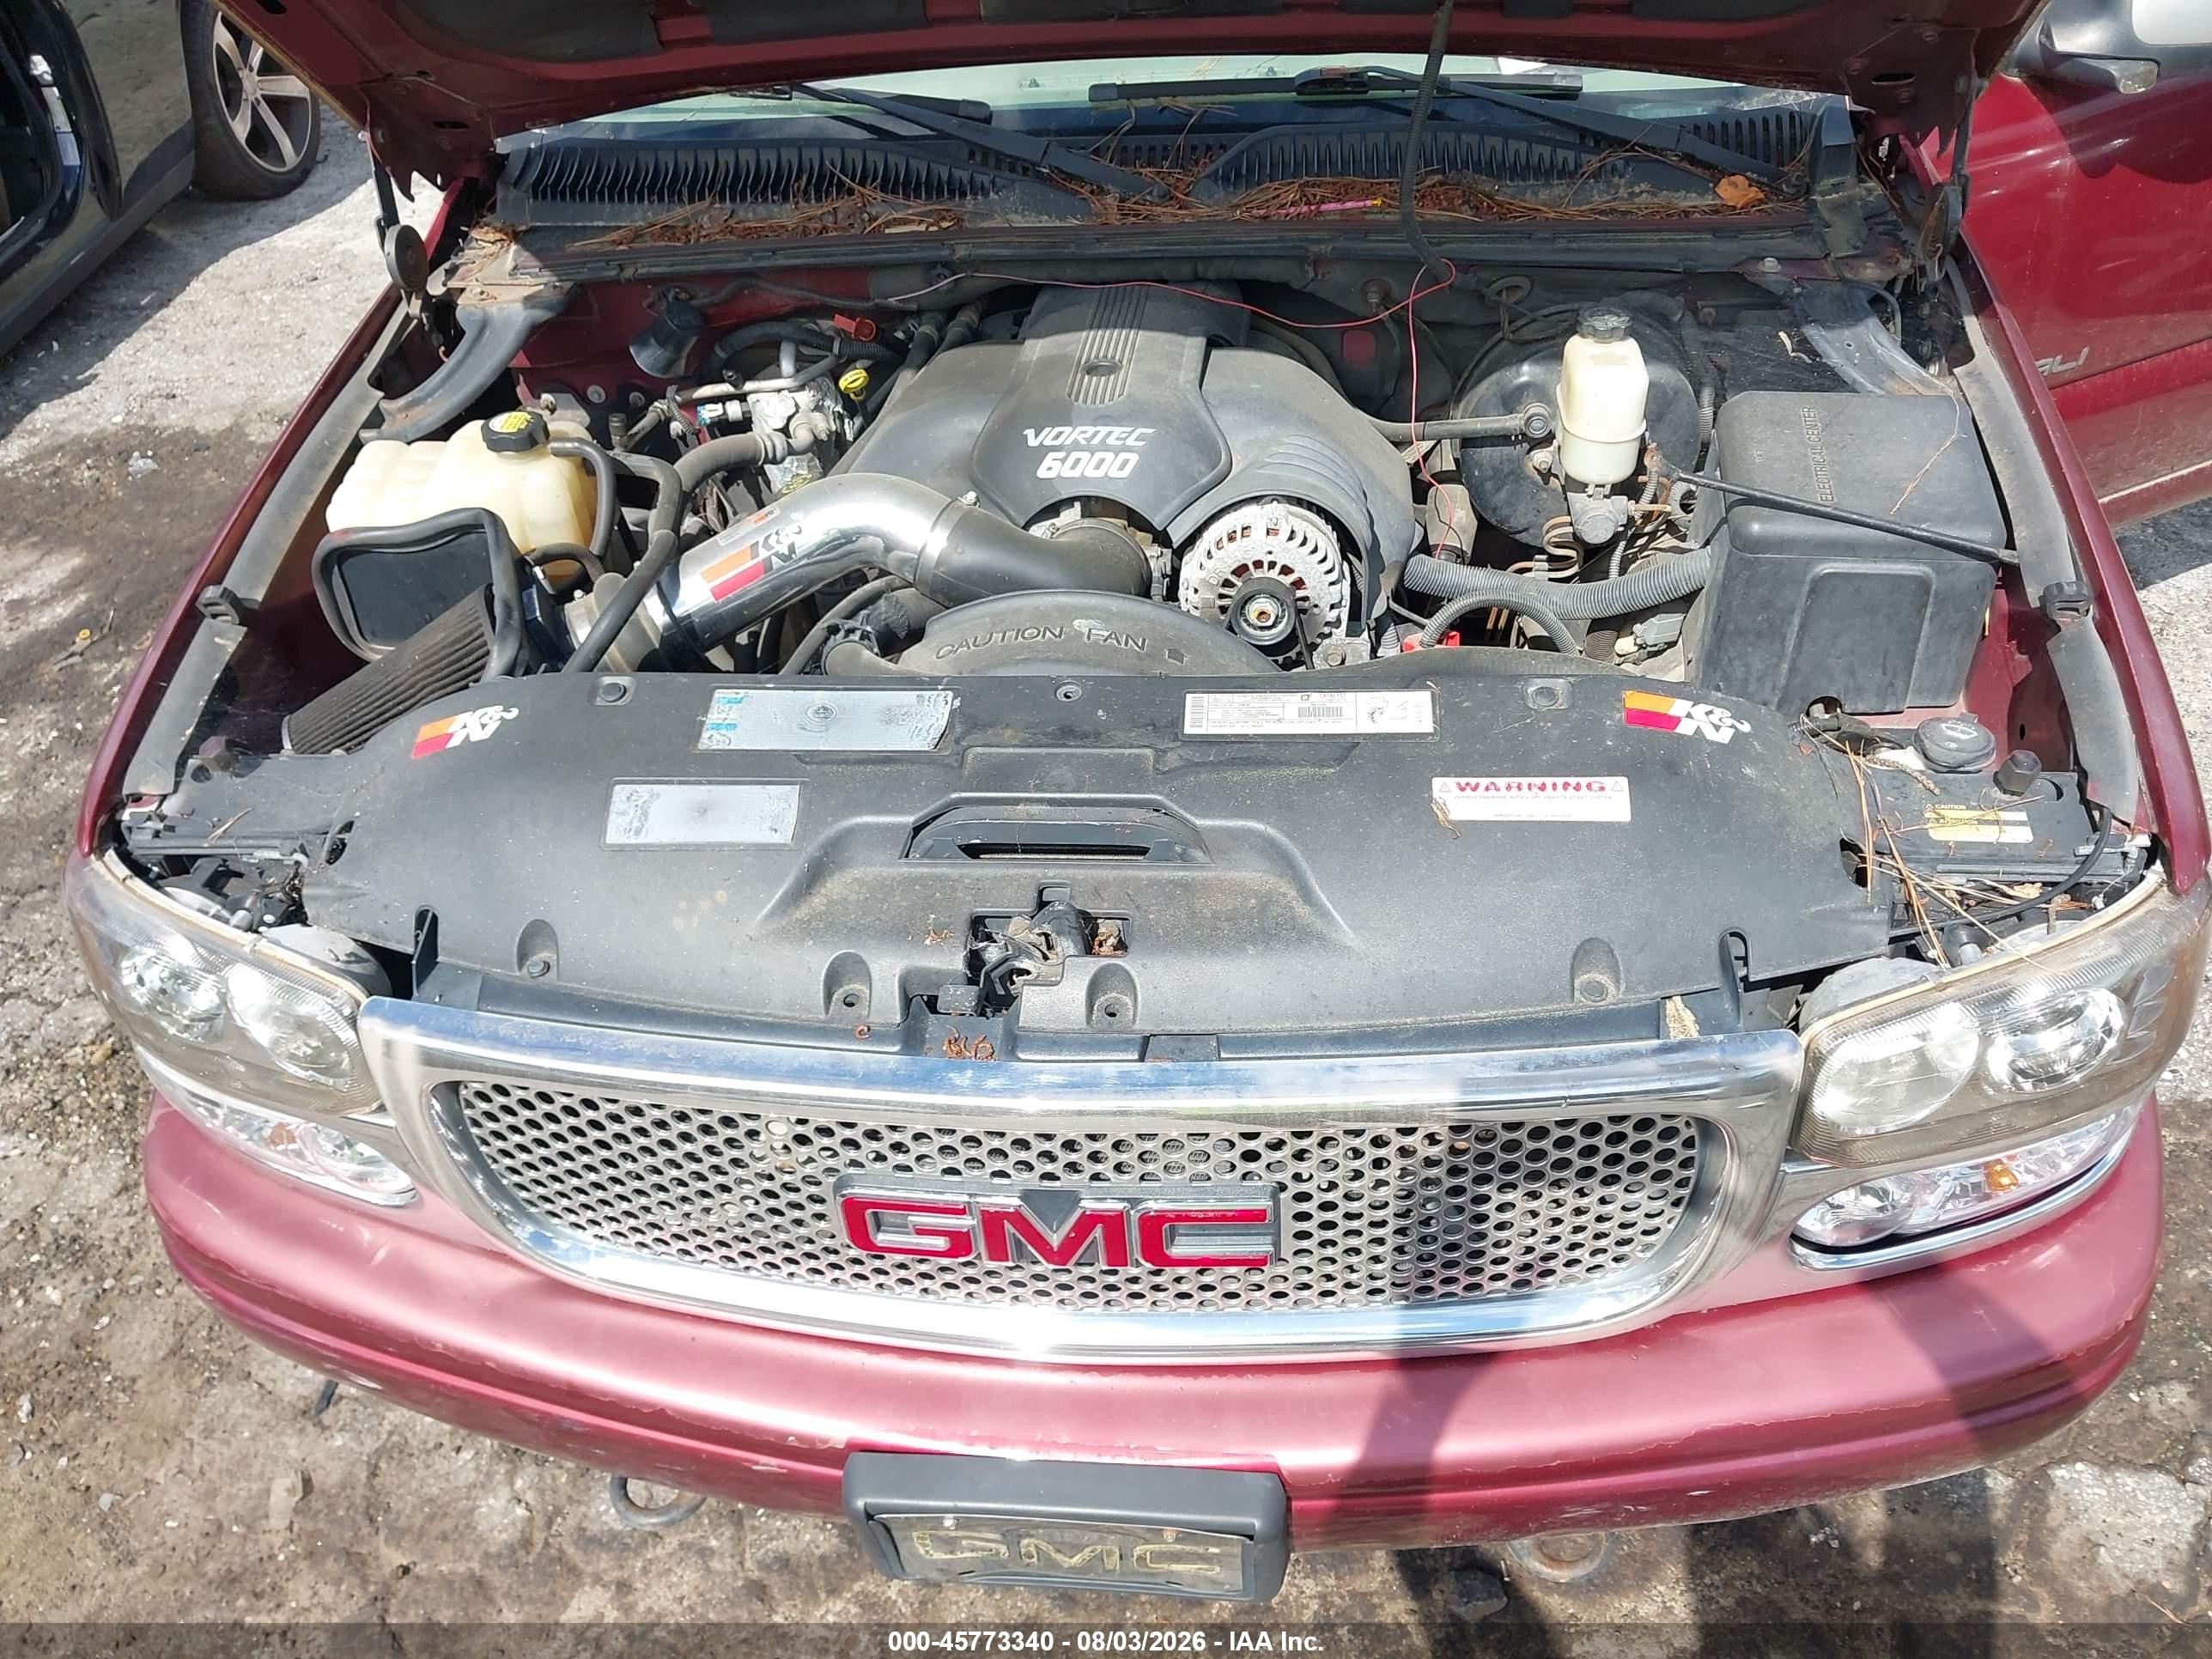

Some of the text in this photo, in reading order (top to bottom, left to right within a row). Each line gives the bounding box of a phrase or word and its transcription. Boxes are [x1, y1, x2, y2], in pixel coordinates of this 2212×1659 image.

[1023, 425, 1157, 447] VORTEC
[1801, 406, 1835, 503] ELECTRICAL CENTER
[1036, 451, 1140, 479] 6000
[934, 625, 1148, 660] CAUTION FAN
[444, 705, 519, 749] K&N
[1668, 697, 1752, 744] K&N
[1455, 781, 1607, 792] WARNING
[840, 1191, 1274, 1268] GMC
[913, 1530, 1222, 1574] GMC
